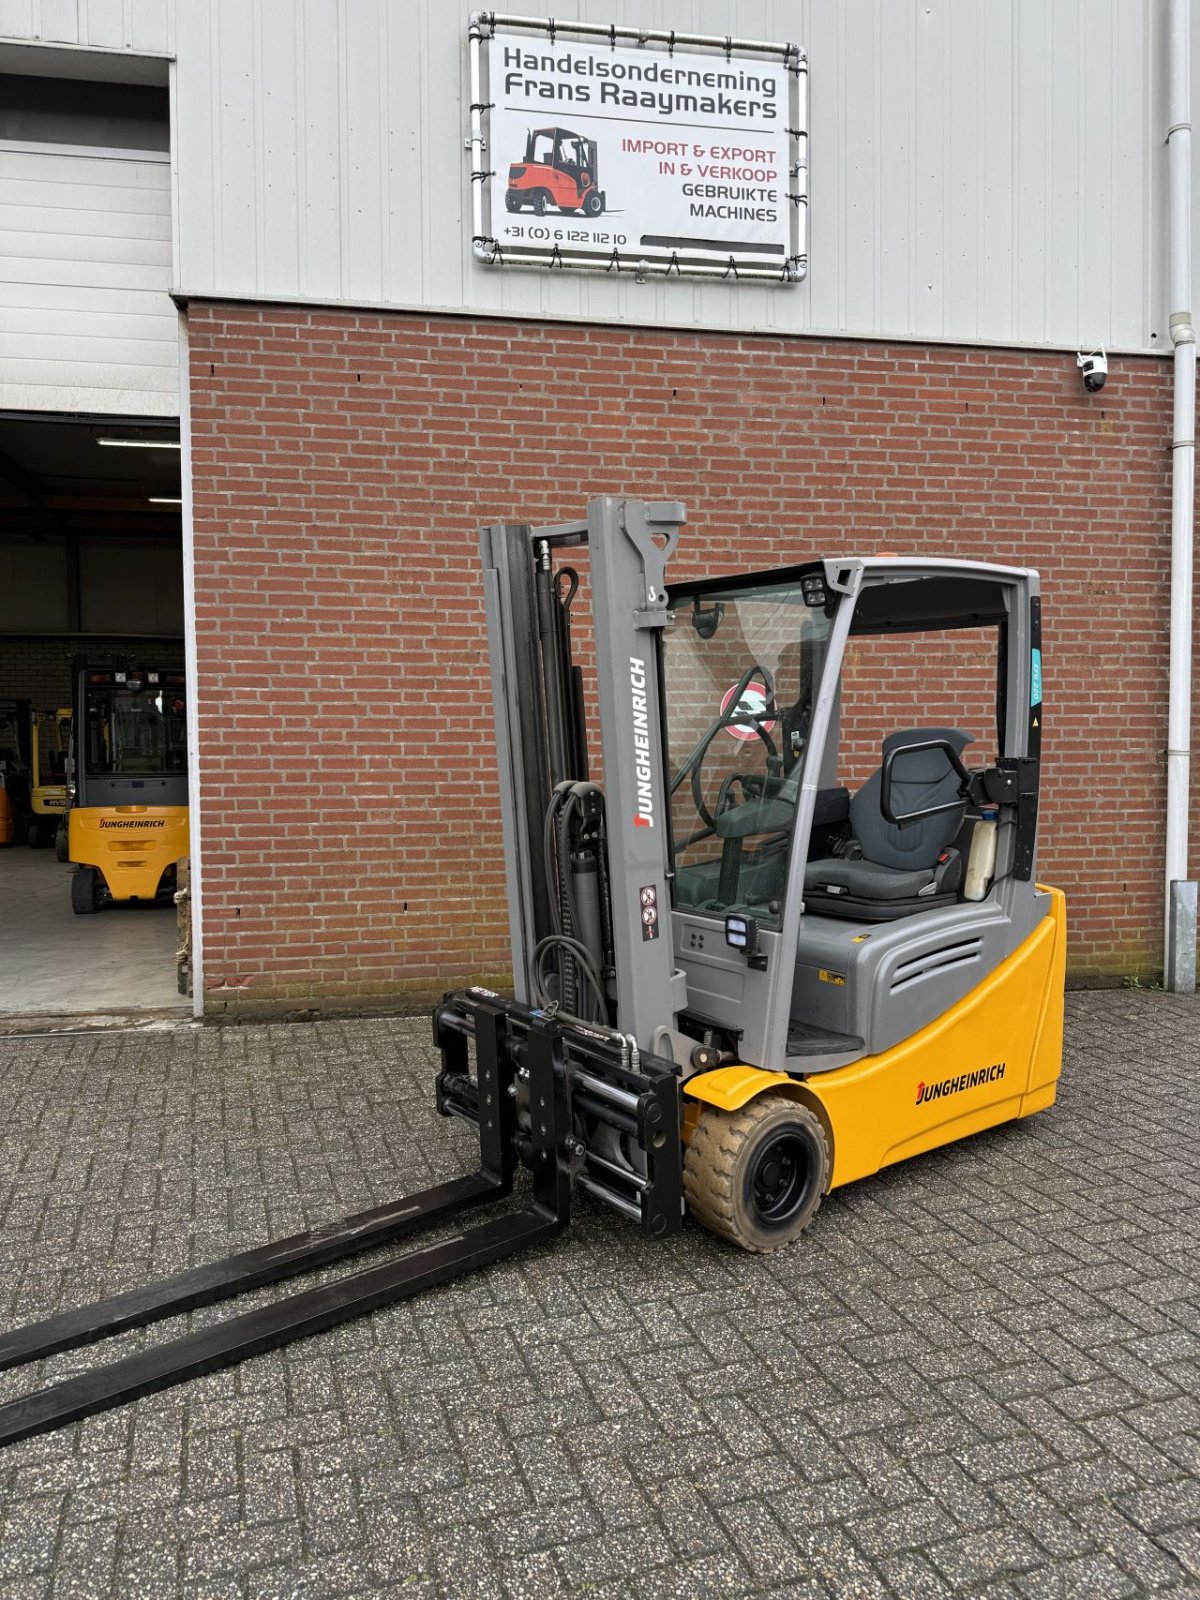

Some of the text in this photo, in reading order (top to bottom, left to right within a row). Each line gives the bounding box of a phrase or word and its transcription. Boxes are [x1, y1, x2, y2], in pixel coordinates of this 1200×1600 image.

[504, 46, 776, 98] Handelsonderneming
[505, 72, 777, 119] Frans Raaymakers
[622, 138, 777, 164] IMPORT & EXPORT
[659, 161, 777, 183] IN & VERKOOP
[682, 183, 777, 203] GEBRUIKTE
[690, 203, 777, 222] MACHINES
[504, 226, 627, 246] +31 (0) 6 122 112 10
[630, 657, 655, 829] JUNGHEINRICH
[99, 818, 165, 829] JUNGHEINRICH
[916, 1062, 1006, 1106] JUNGHEINRICH
